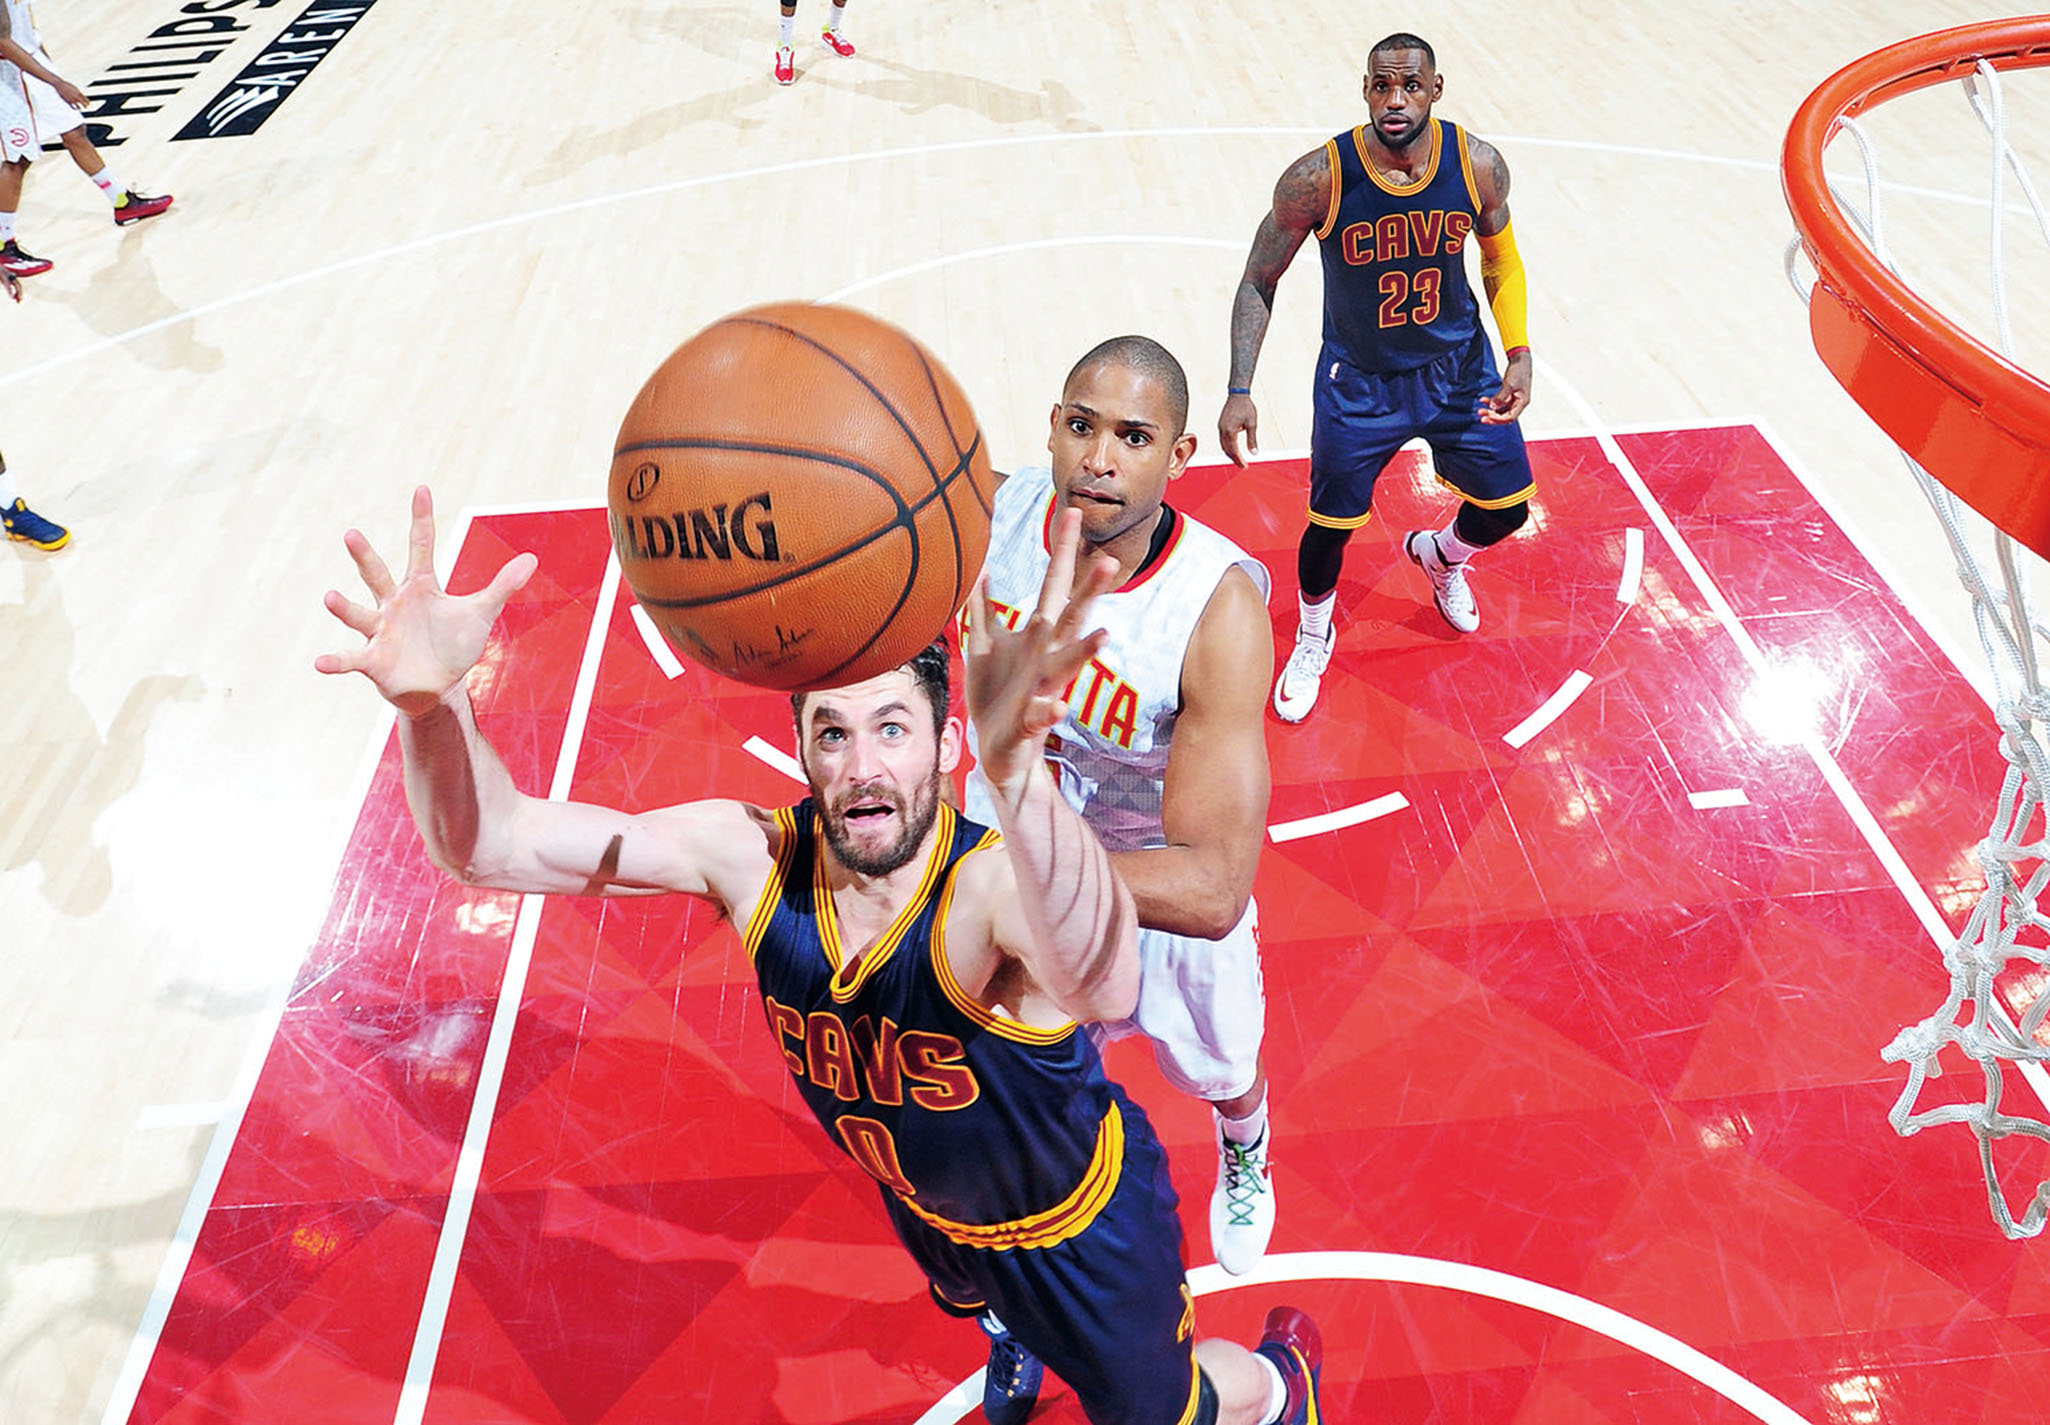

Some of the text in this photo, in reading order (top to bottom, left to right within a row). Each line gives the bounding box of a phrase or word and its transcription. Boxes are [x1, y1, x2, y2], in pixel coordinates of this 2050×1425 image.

[1341, 210, 1473, 266] CAVS
[1379, 267, 1442, 329] 23
[612, 491, 780, 562] LDING
[766, 996, 980, 1111] CAVS
